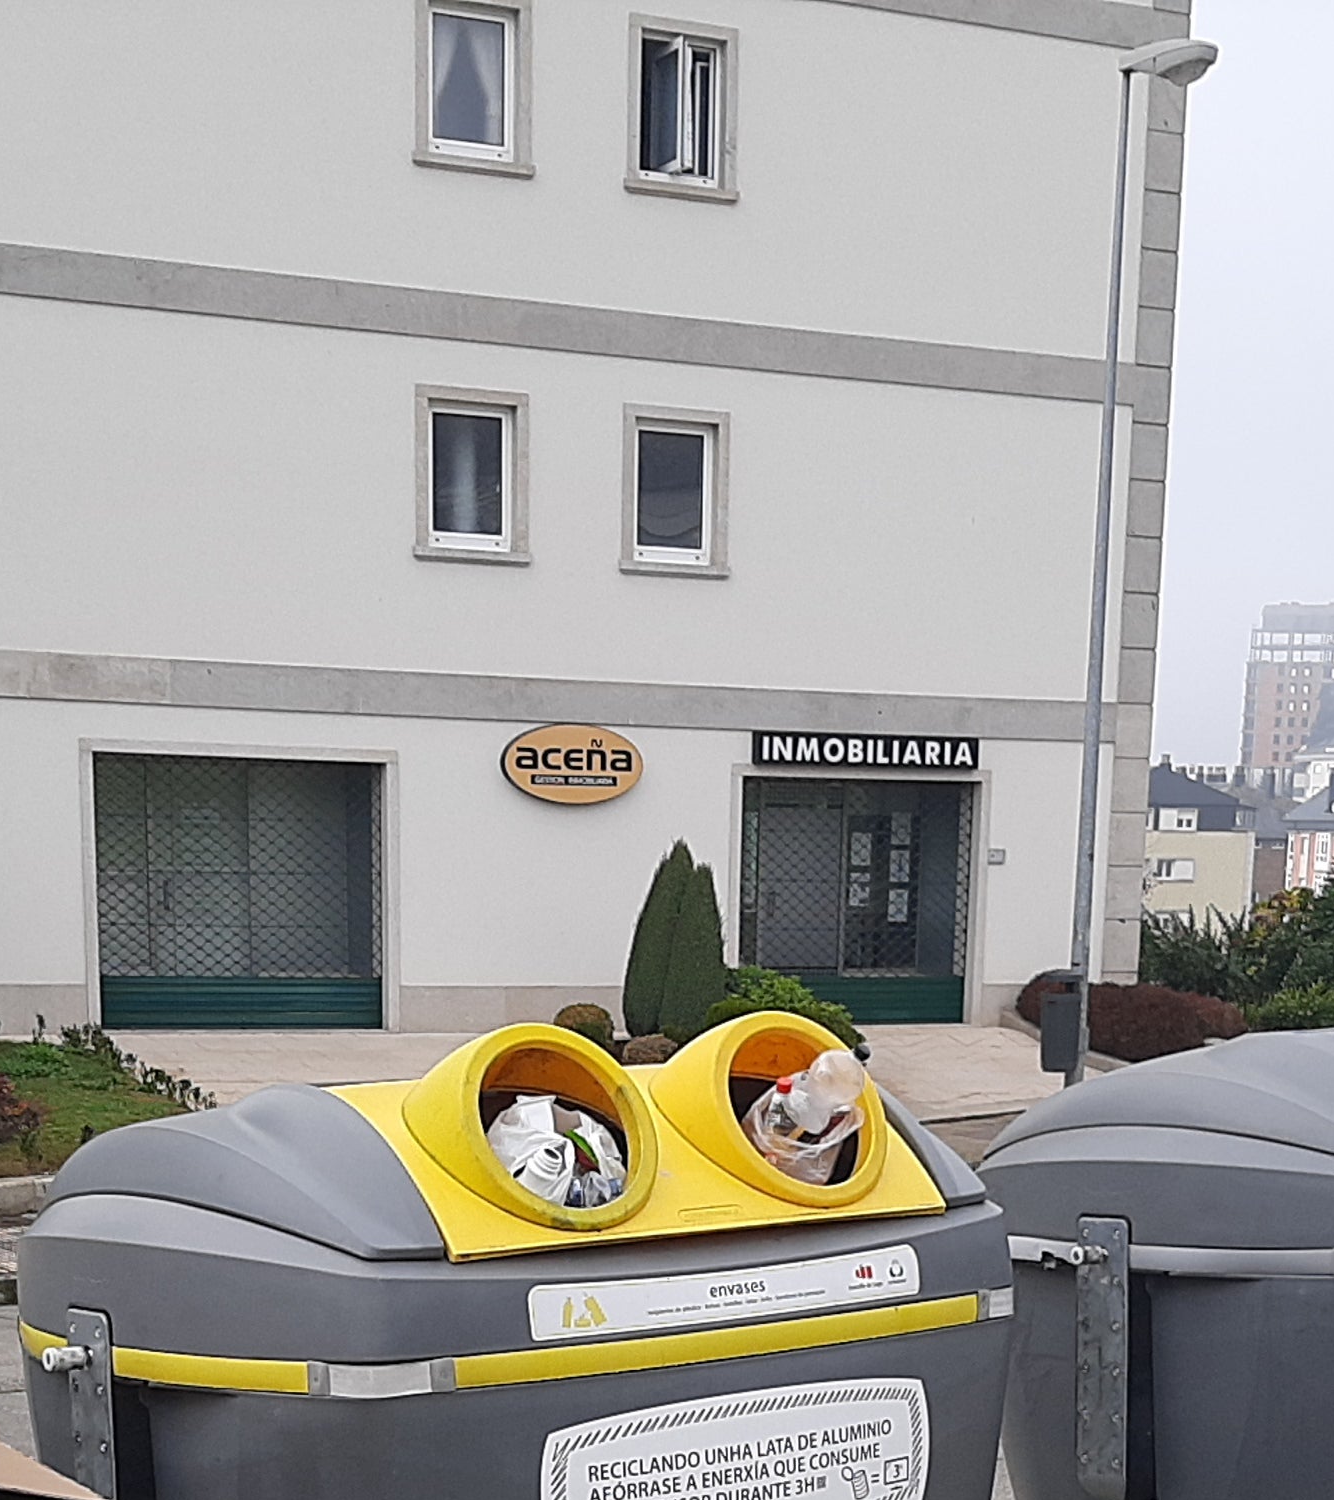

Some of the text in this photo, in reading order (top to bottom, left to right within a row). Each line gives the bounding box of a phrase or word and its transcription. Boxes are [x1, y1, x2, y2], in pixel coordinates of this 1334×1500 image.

[515, 738, 632, 772] aceña
[762, 736, 973, 766] INMOBILIARIA
[710, 1280, 766, 1298] envases
[588, 1419, 892, 1482] RECICLANDO UNHA LATA DE ALUMINIO
[686, 1474, 697, 1491] A
[702, 1461, 770, 1488] ENERXÍA
[774, 1456, 806, 1476] QUE
[809, 1443, 880, 1469] CONSUME
[795, 1477, 815, 1495] 3H
